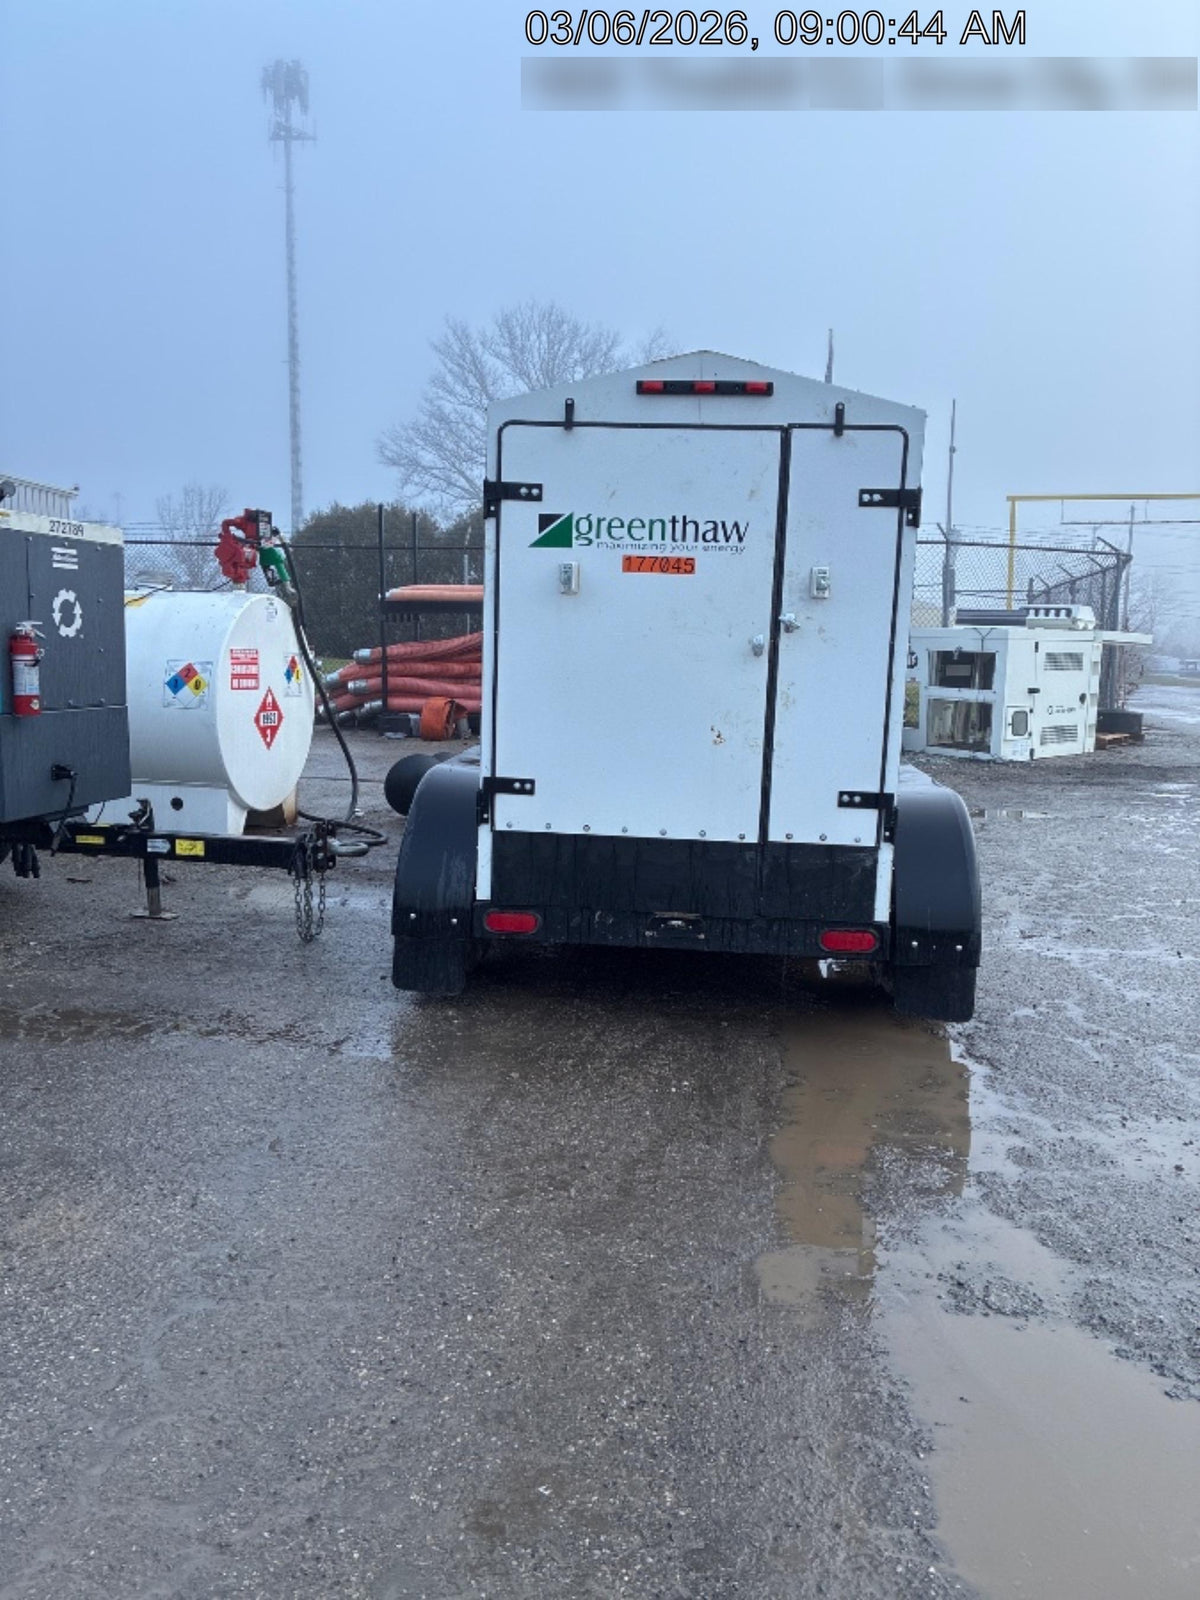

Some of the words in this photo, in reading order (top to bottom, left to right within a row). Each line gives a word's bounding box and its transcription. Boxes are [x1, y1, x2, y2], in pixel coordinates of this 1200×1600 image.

[574, 514, 749, 546] greenthaw
[671, 544, 698, 554] your
[624, 556, 695, 574] 177045
